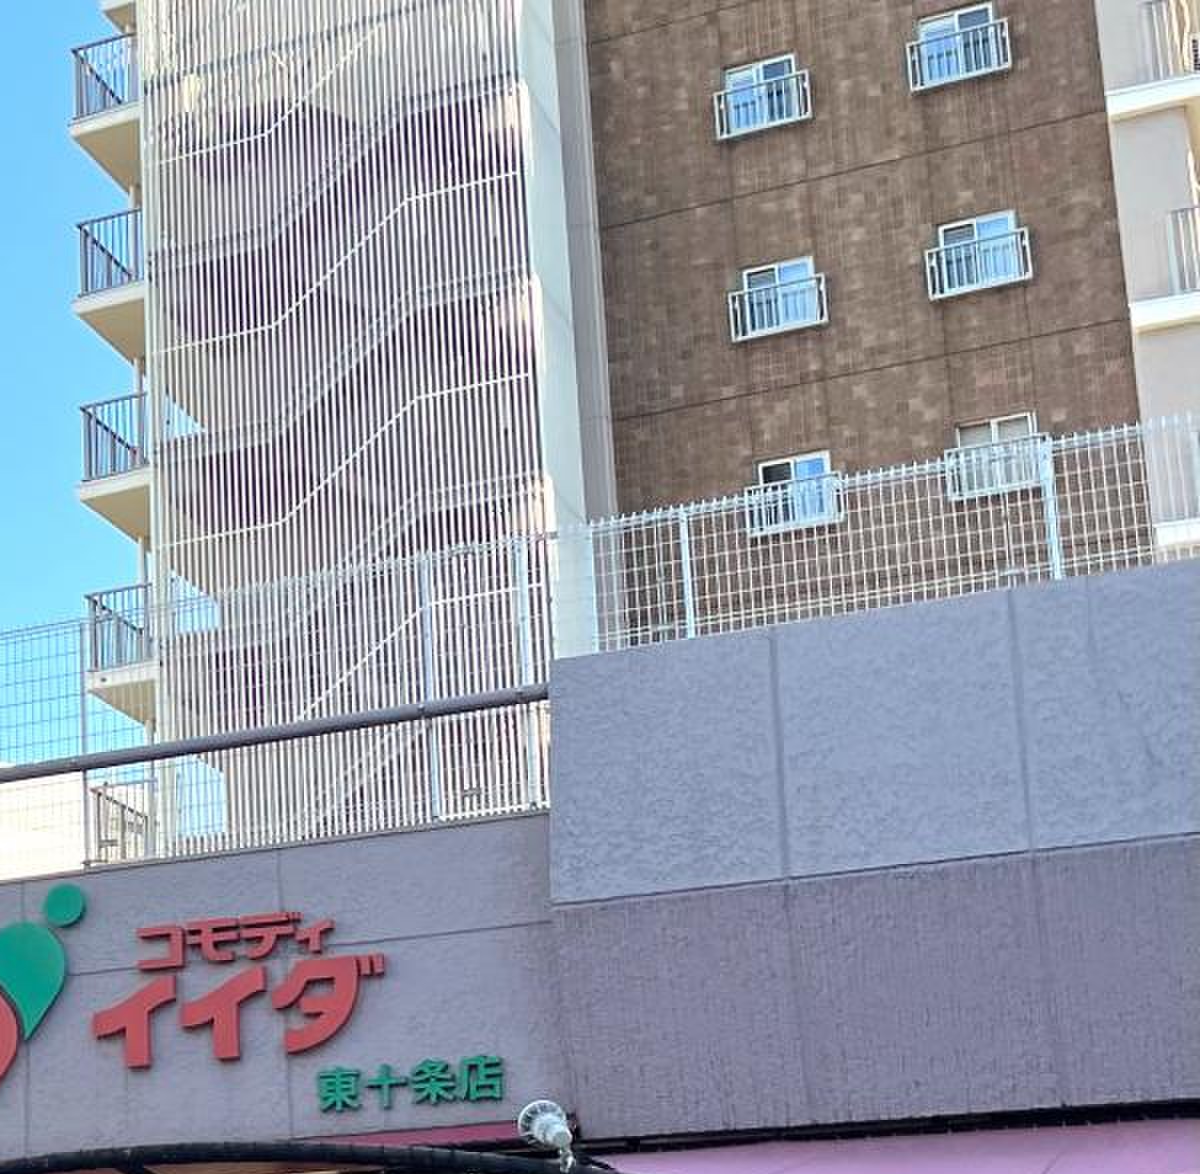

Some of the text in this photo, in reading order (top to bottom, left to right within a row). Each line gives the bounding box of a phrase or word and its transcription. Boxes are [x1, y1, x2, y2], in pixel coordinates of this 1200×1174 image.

[136, 911, 336, 971] コモディ
[92, 953, 385, 1070] イイダ
[317, 1055, 505, 1113] 東十条店
